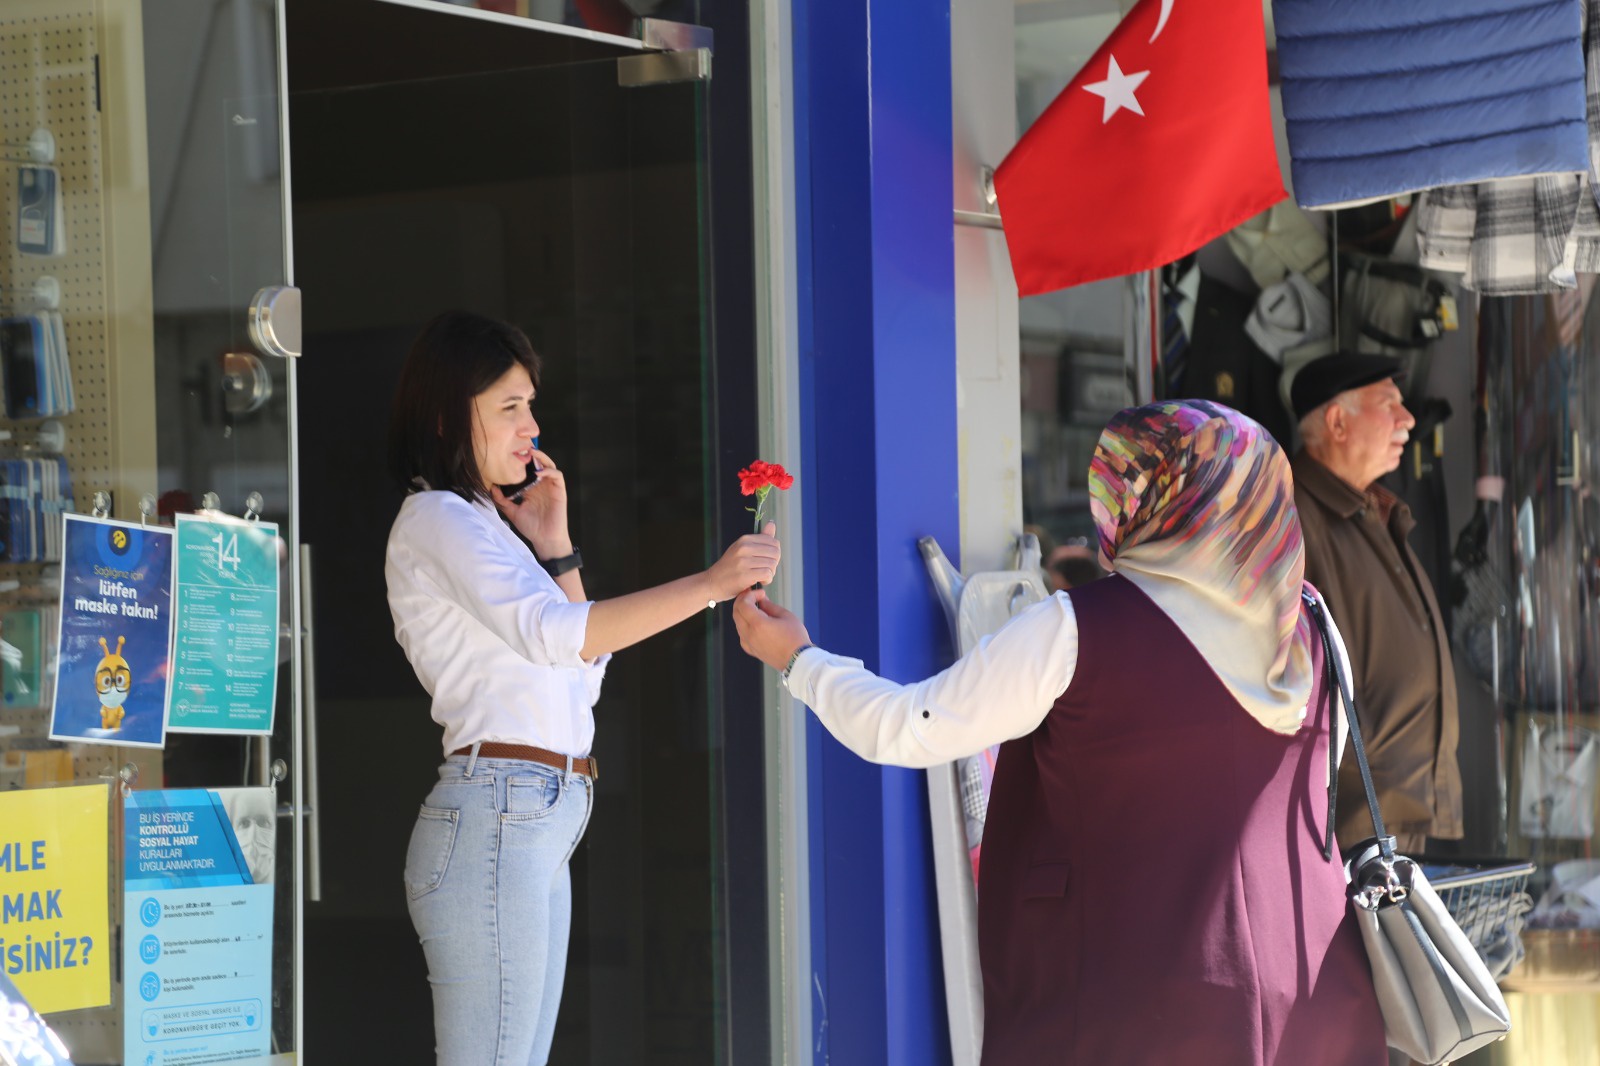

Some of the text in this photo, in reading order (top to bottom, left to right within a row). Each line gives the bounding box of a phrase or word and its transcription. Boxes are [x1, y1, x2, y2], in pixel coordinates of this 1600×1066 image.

[212, 532, 241, 571] 14
[99, 579, 137, 599] lütfen
[75, 598, 158, 620] maske takın!
[140, 814, 151, 823] BU
[162, 811, 194, 822] YERİNDE
[140, 823, 189, 835] KONTROLLÜ
[140, 836, 198, 847] SOSYAL HAYAT
[140, 848, 182, 859] KURALLARI
[0, 889, 62, 924] MAK
